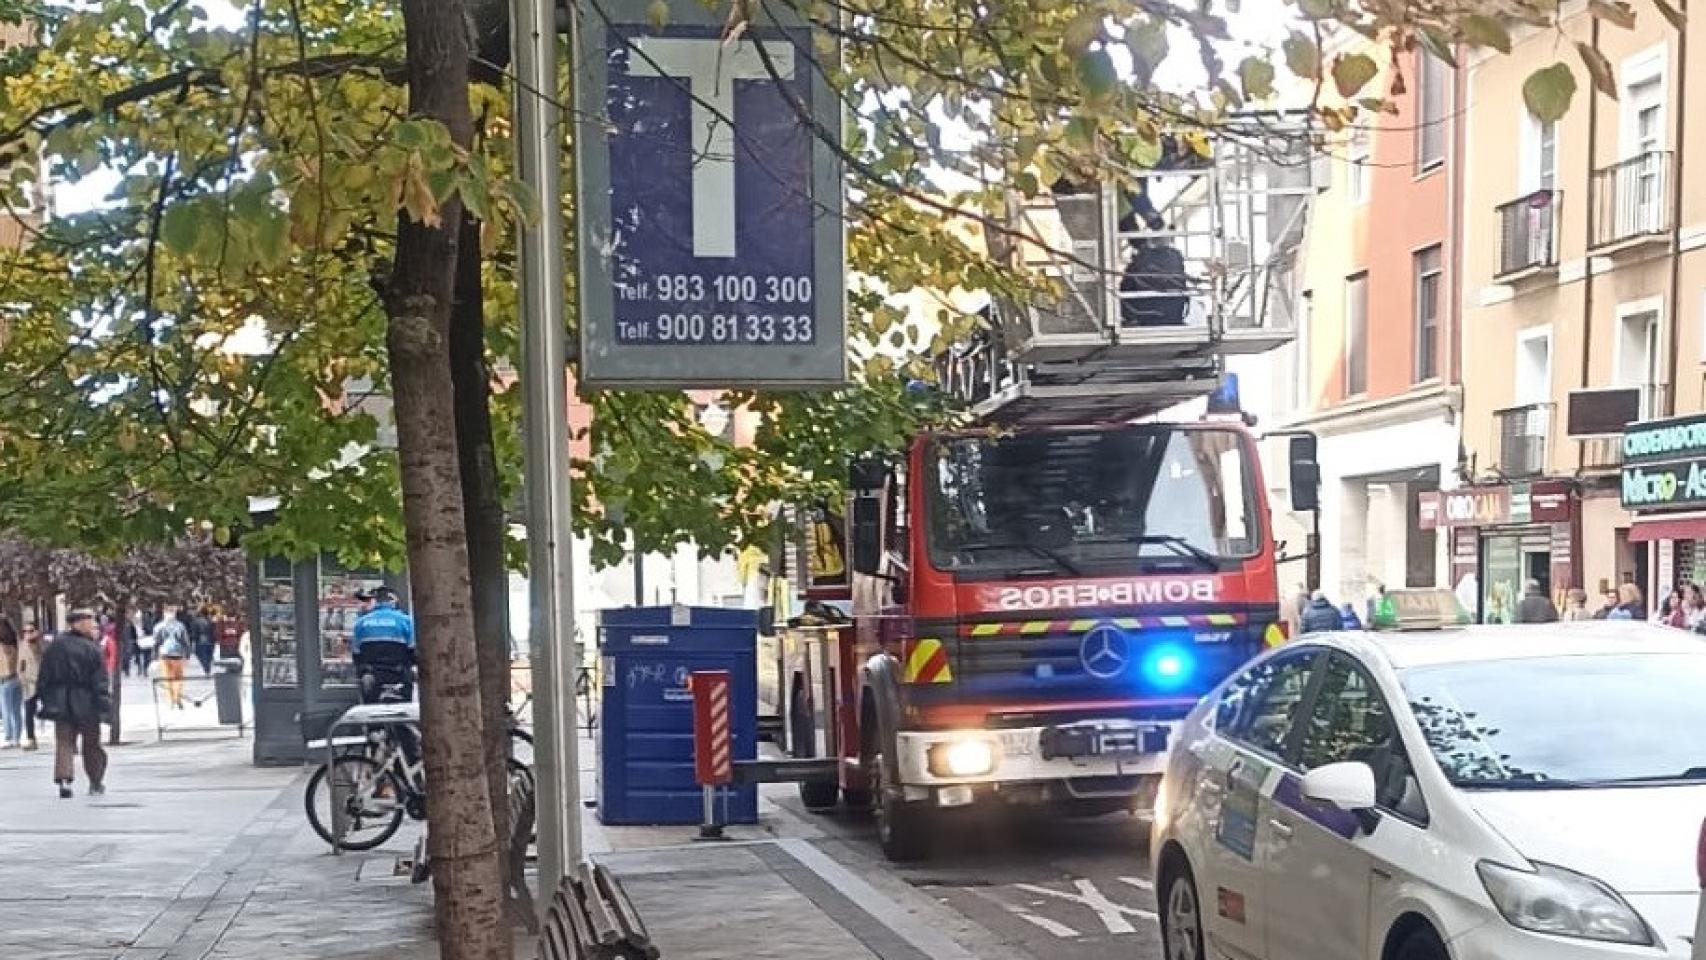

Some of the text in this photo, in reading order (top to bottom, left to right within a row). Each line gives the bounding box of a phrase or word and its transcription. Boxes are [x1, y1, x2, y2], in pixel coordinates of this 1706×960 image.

[627, 36, 795, 258] T
[657, 275, 704, 301] 983
[712, 275, 756, 302] 100
[765, 276, 812, 302] 300
[657, 314, 704, 340] 900
[711, 314, 738, 340] 81
[745, 315, 775, 341] 33
[782, 315, 812, 341] 33
